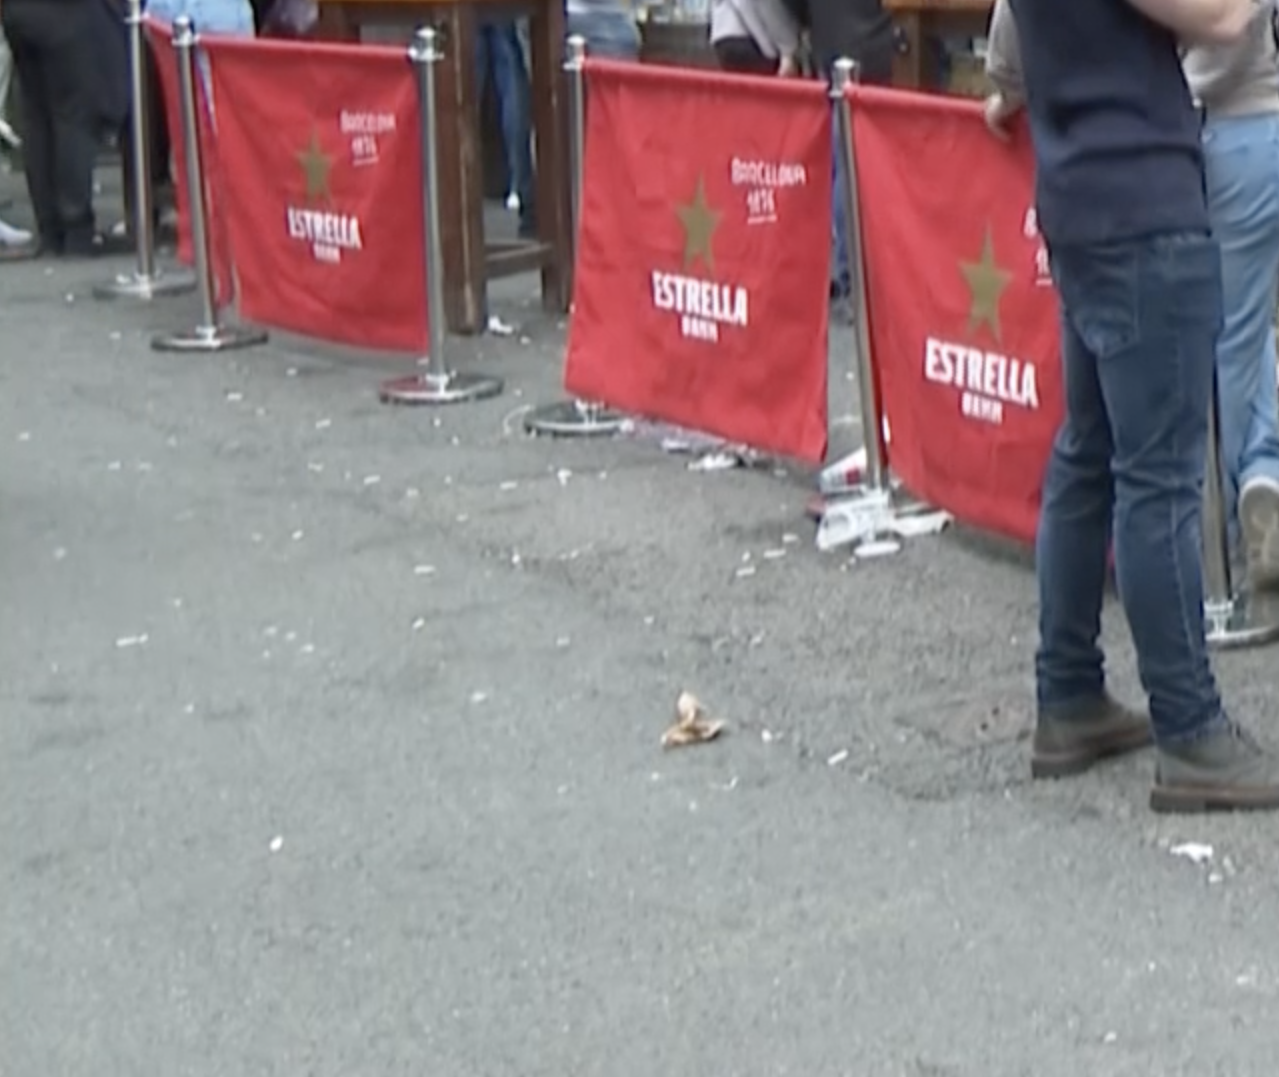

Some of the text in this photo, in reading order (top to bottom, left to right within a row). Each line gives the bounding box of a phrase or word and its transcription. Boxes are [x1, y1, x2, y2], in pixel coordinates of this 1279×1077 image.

[287, 207, 362, 250] ESTRELLA
[652, 269, 749, 327] ESTRELLA
[925, 336, 1039, 409] ESTRELLA
